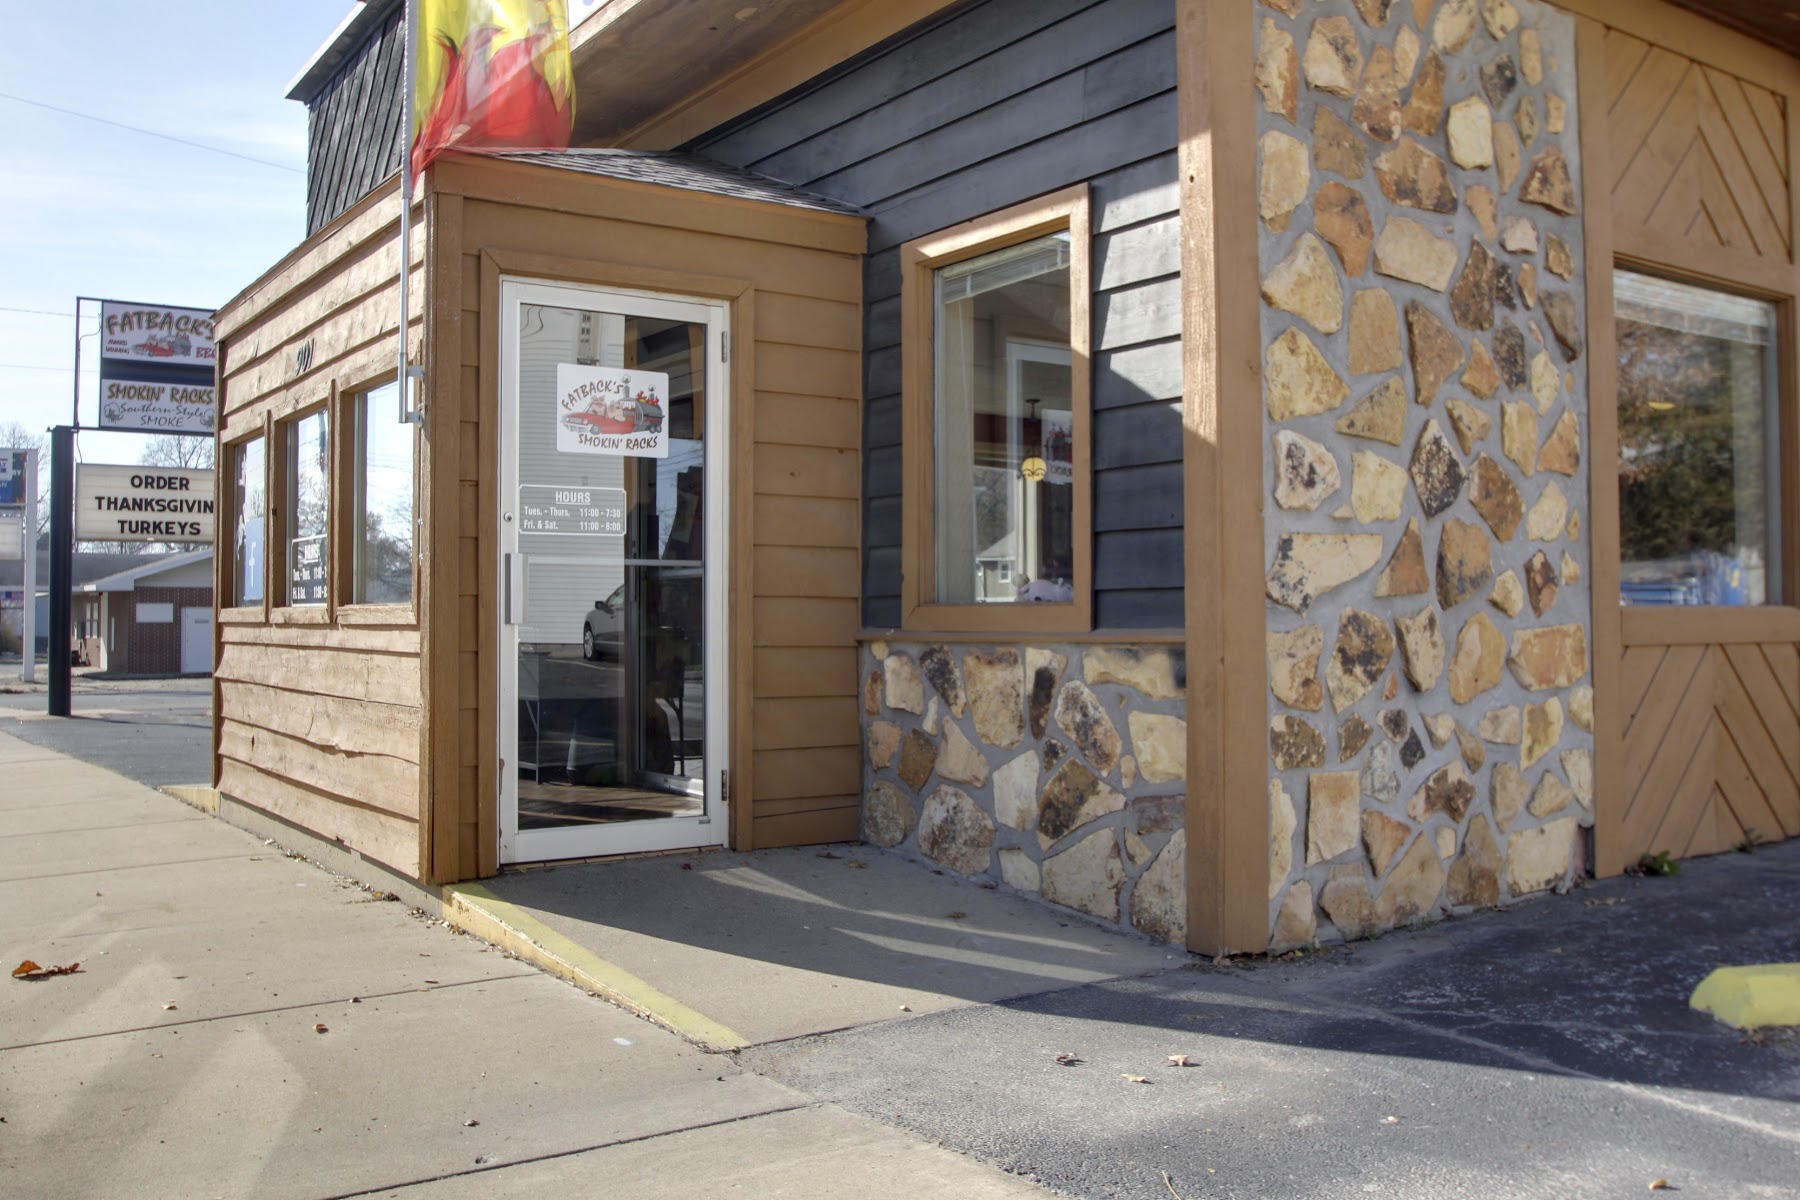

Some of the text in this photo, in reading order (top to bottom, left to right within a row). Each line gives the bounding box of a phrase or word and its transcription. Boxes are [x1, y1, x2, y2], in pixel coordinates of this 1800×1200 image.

[107, 382, 214, 405] SMOKIN' RACKS
[561, 379, 624, 411] FATBACK'S
[140, 414, 184, 428] SMOKE
[578, 433, 658, 450] SMOKIN' RACKS
[130, 474, 190, 491] ORDER
[555, 490, 591, 504] HOURS
[524, 506, 543, 516] Tues.
[549, 507, 571, 517] Thurs.
[580, 508, 599, 518] 11:00
[605, 509, 621, 518] 7:30
[117, 519, 201, 536] TURKEYS
[523, 519, 536, 529] Fri.
[544, 520, 559, 530] Sat.
[580, 521, 599, 531] 11:00
[605, 521, 621, 531] 8:00
